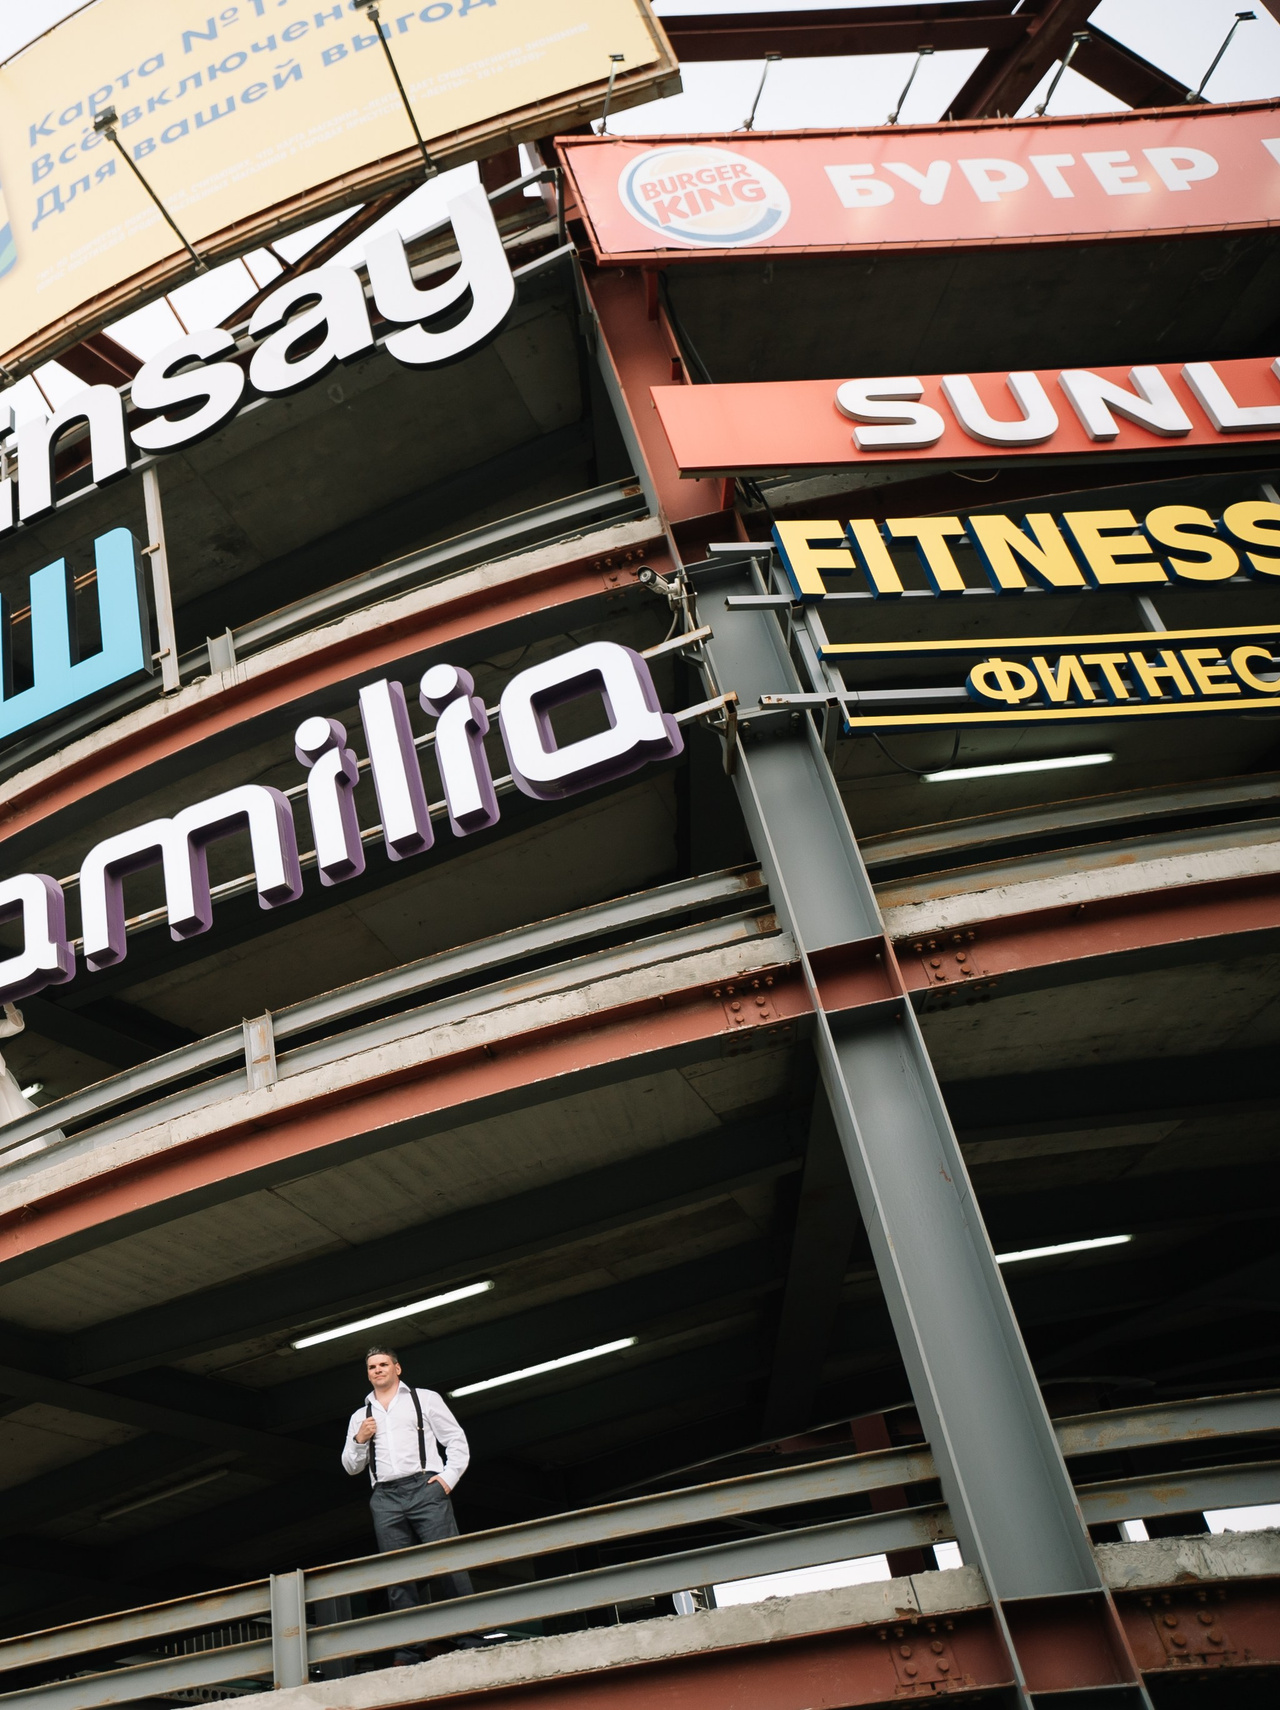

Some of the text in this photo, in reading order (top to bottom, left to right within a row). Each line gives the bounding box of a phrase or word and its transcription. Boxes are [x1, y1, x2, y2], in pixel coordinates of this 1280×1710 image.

[29, 52, 165, 148] Карта
[31, 158, 117, 233] Для
[133, 58, 304, 163] вашей
[31, 125, 105, 186] Всё
[639, 163, 752, 201] BURGER
[652, 178, 767, 226] KING
[824, 146, 1220, 209] БУРГЕР
[834, 361, 1280, 453] SUNL
